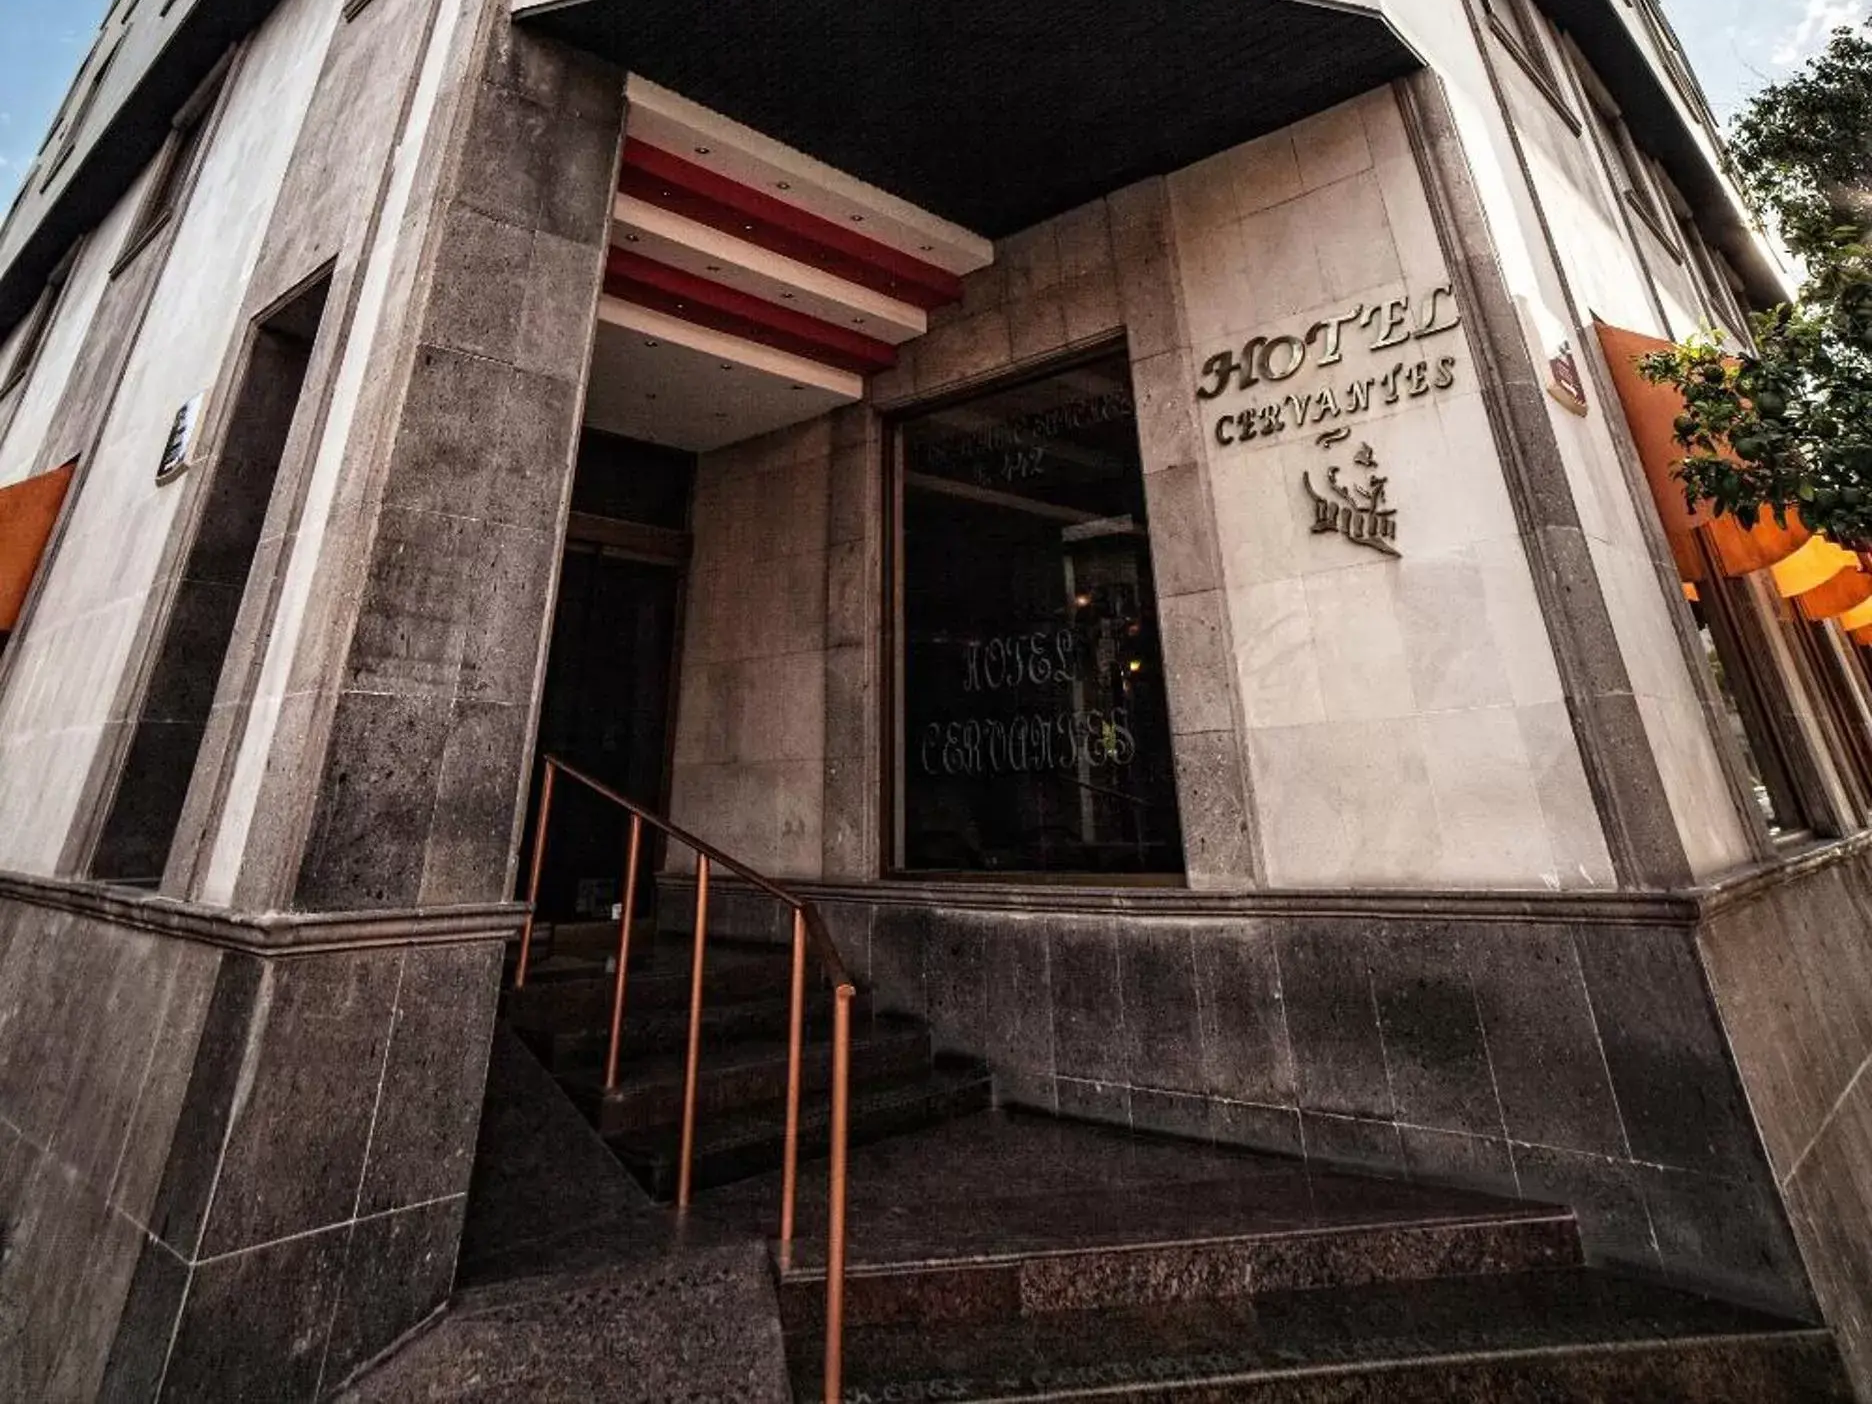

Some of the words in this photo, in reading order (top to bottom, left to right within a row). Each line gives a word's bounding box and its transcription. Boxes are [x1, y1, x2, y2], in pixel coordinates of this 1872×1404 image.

[1195, 284, 1461, 399] HOTEL
[1215, 356, 1456, 445] CERVANTES
[963, 628, 1076, 692] HOTEL
[921, 707, 1135, 775] CERVANTES
